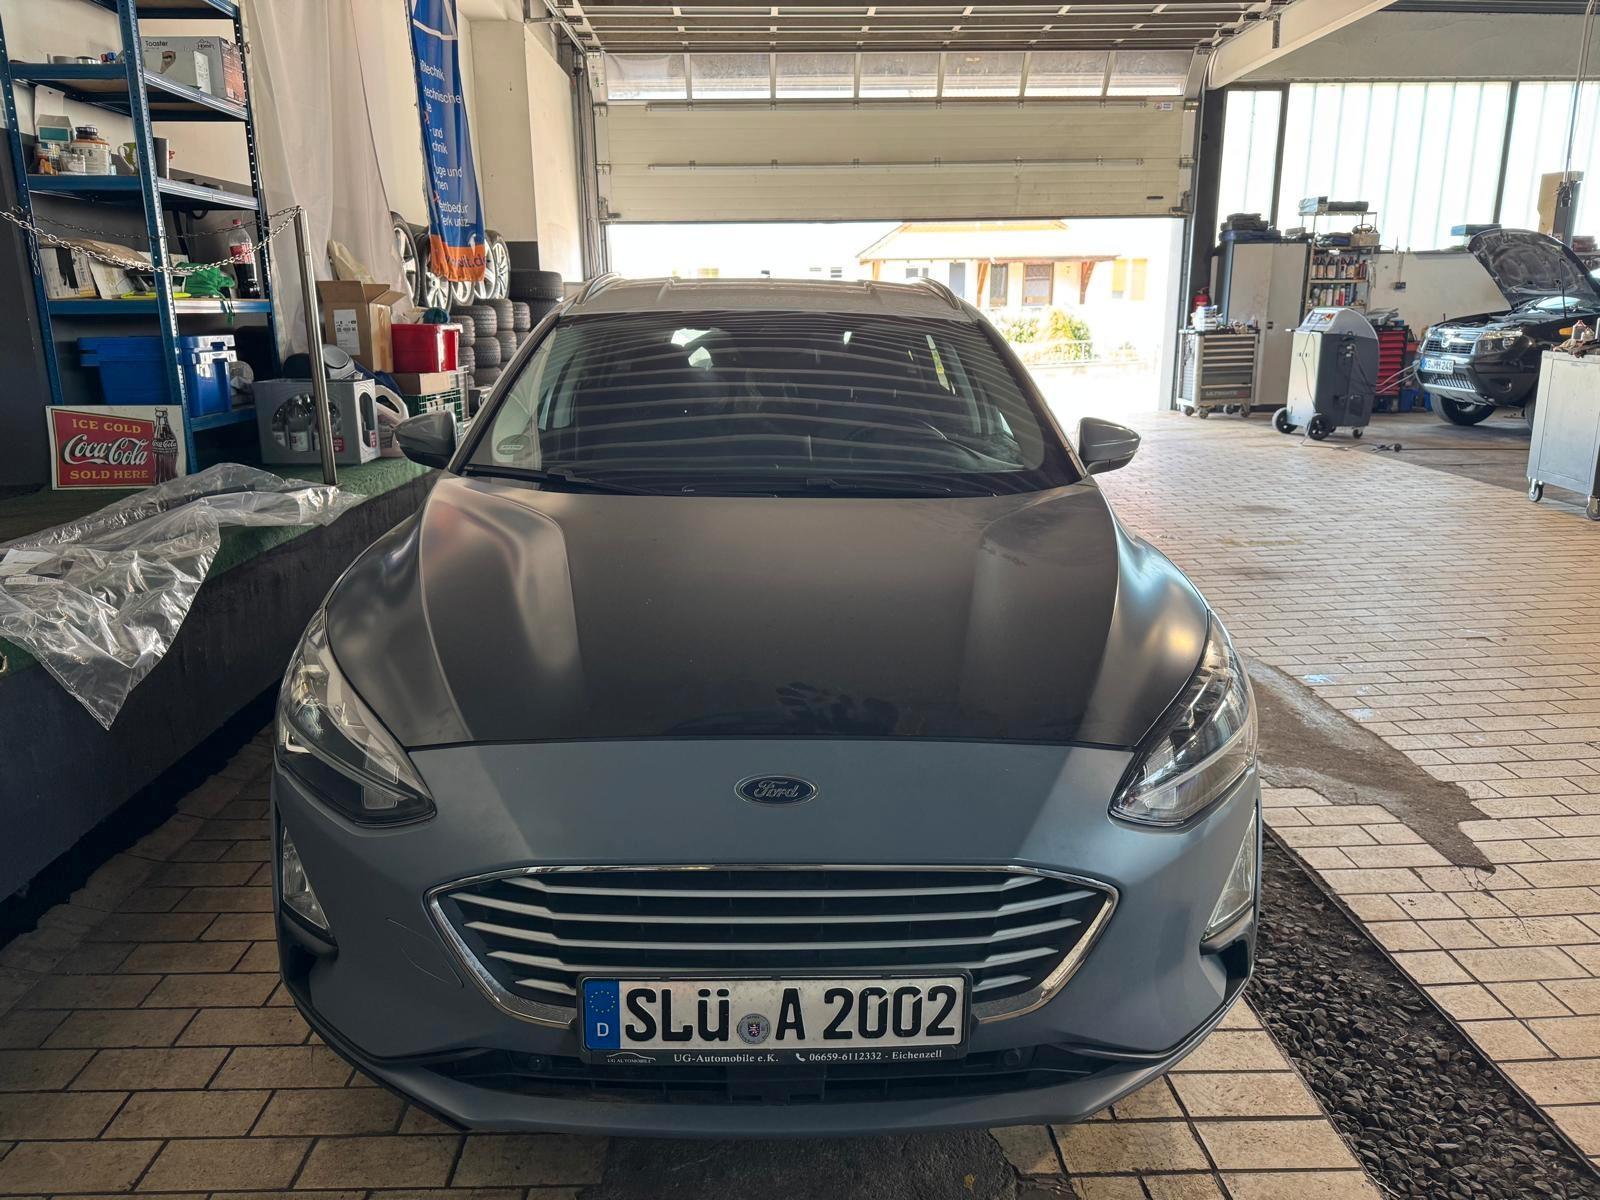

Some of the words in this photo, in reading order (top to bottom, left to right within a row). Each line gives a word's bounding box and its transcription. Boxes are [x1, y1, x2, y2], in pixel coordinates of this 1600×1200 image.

[446, 166, 463, 178] und
[72, 419, 99, 430] ICE
[103, 421, 141, 433] COLD
[70, 470, 110, 479] SOLD
[114, 469, 149, 479] HERE
[753, 780, 800, 797] Ford
[775, 988, 805, 1040] A
[823, 985, 957, 1040] 2002
[597, 1022, 609, 1037] D
[673, 1053, 754, 1063] UG-Automobile
[757, 1053, 779, 1062] e.K.
[809, 1052, 882, 1062] 06659-6112332
[892, 1050, 943, 1060] Eichenzell
